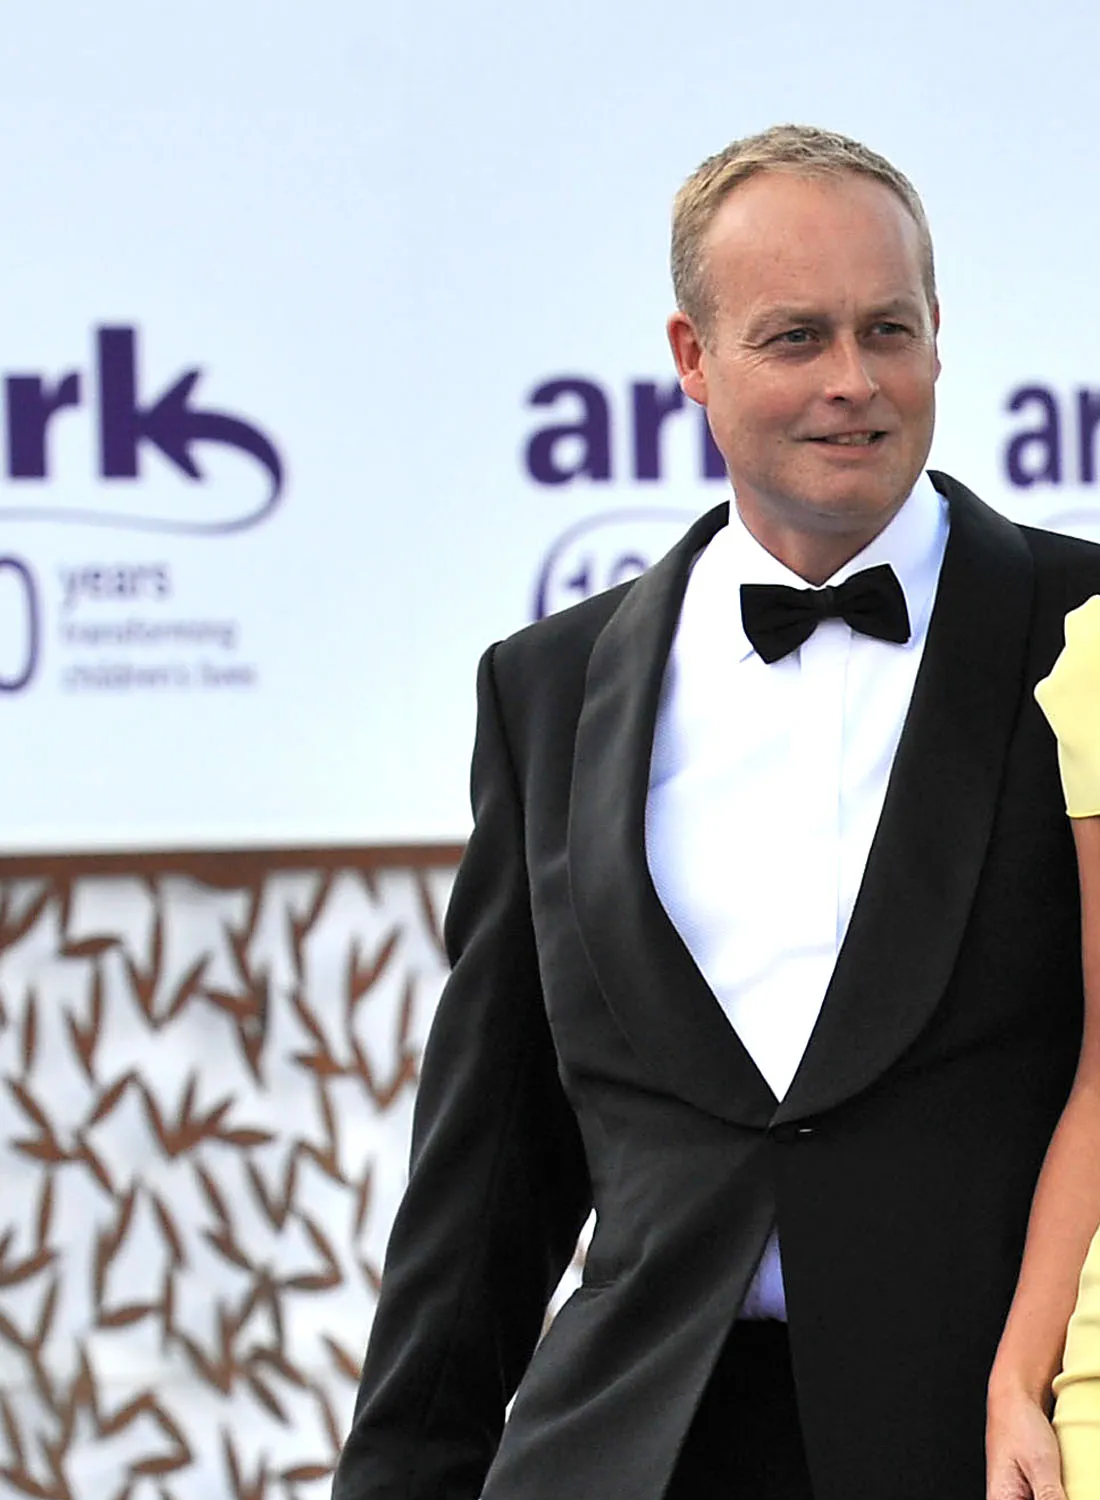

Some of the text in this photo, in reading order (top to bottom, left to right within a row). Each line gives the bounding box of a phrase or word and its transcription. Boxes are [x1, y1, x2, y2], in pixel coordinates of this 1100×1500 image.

[4, 326, 284, 480] rk
[523, 375, 730, 486] ar
[60, 564, 169, 608] years
